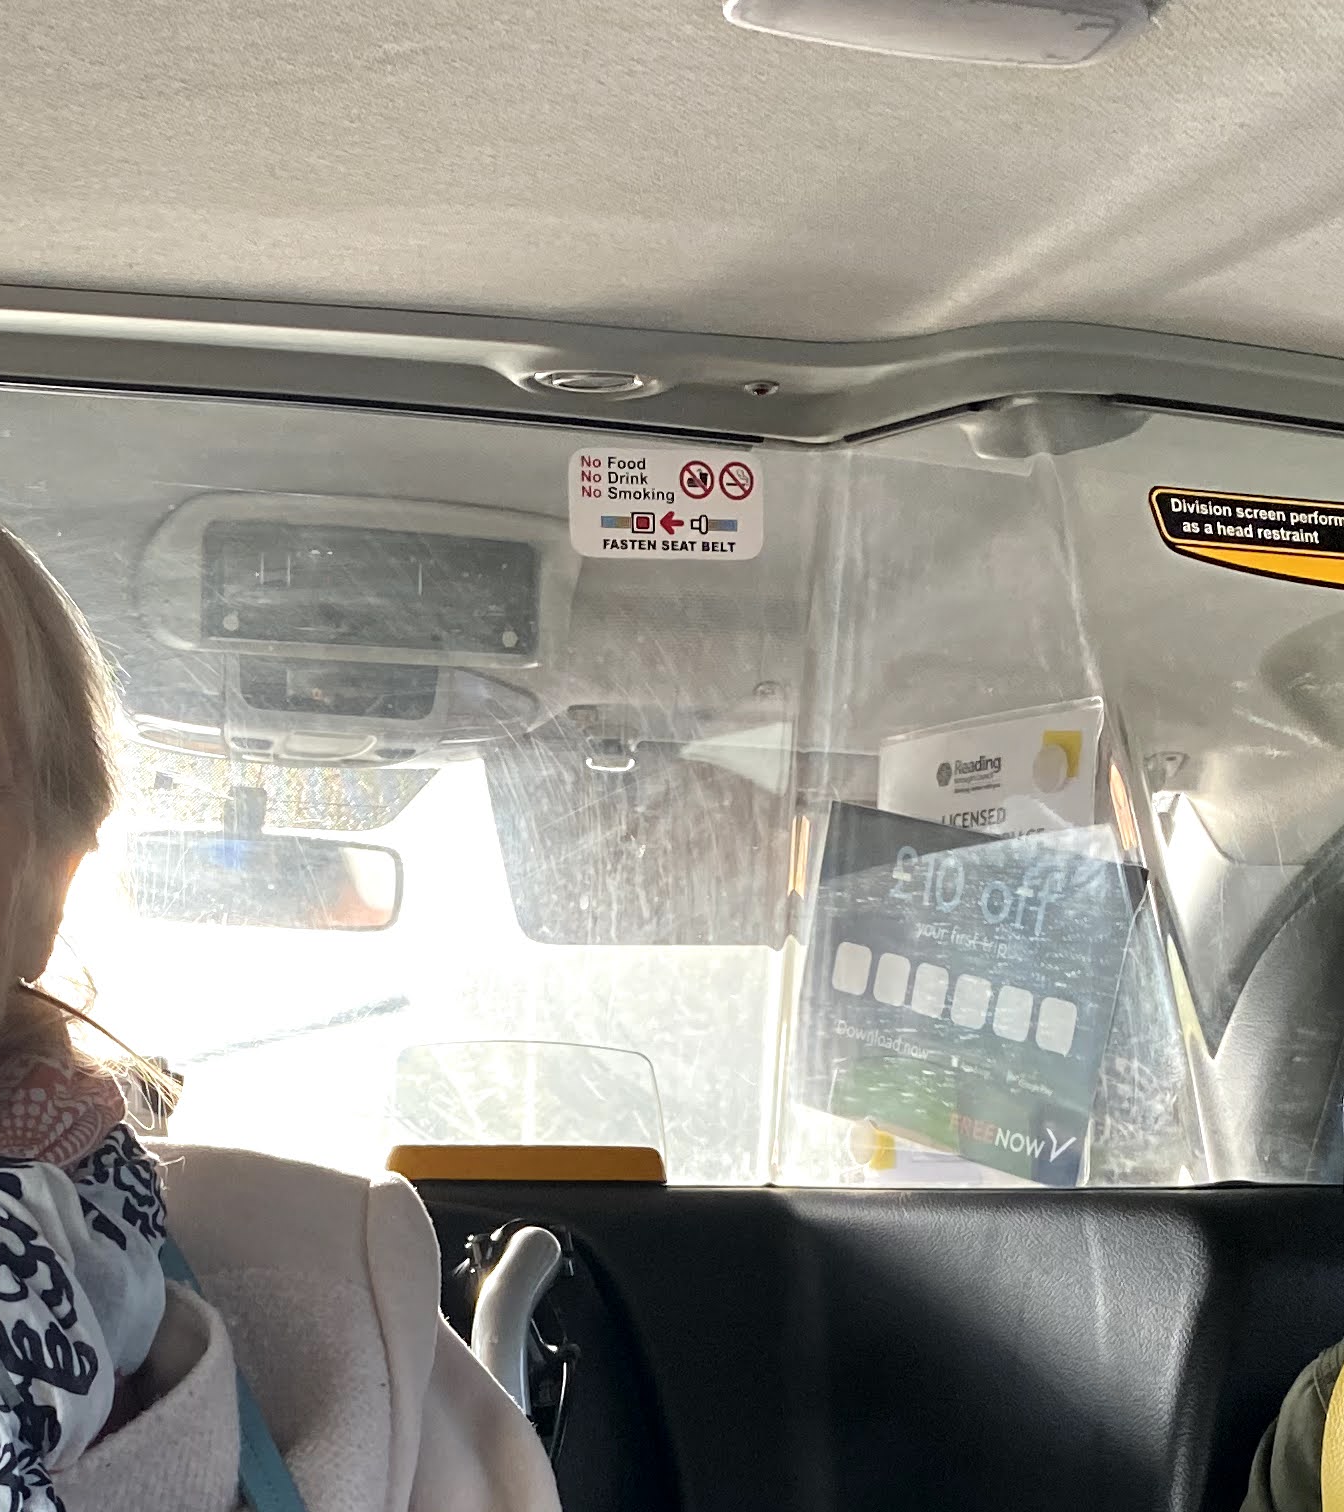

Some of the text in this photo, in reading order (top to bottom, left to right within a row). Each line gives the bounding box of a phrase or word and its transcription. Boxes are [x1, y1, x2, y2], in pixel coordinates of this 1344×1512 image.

[580, 455, 646, 470] No Food
[580, 470, 649, 485] No Drink
[581, 486, 675, 504] No Smoking
[1170, 497, 1232, 517] Division
[1236, 507, 1286, 522] screen
[1182, 521, 1320, 544] as a head restraint
[602, 538, 737, 553] FASTEN SEAT BELT
[954, 755, 1002, 775] Reading
[889, 846, 966, 913] £10
[914, 921, 948, 940] your
[835, 1019, 929, 1060] Download now
